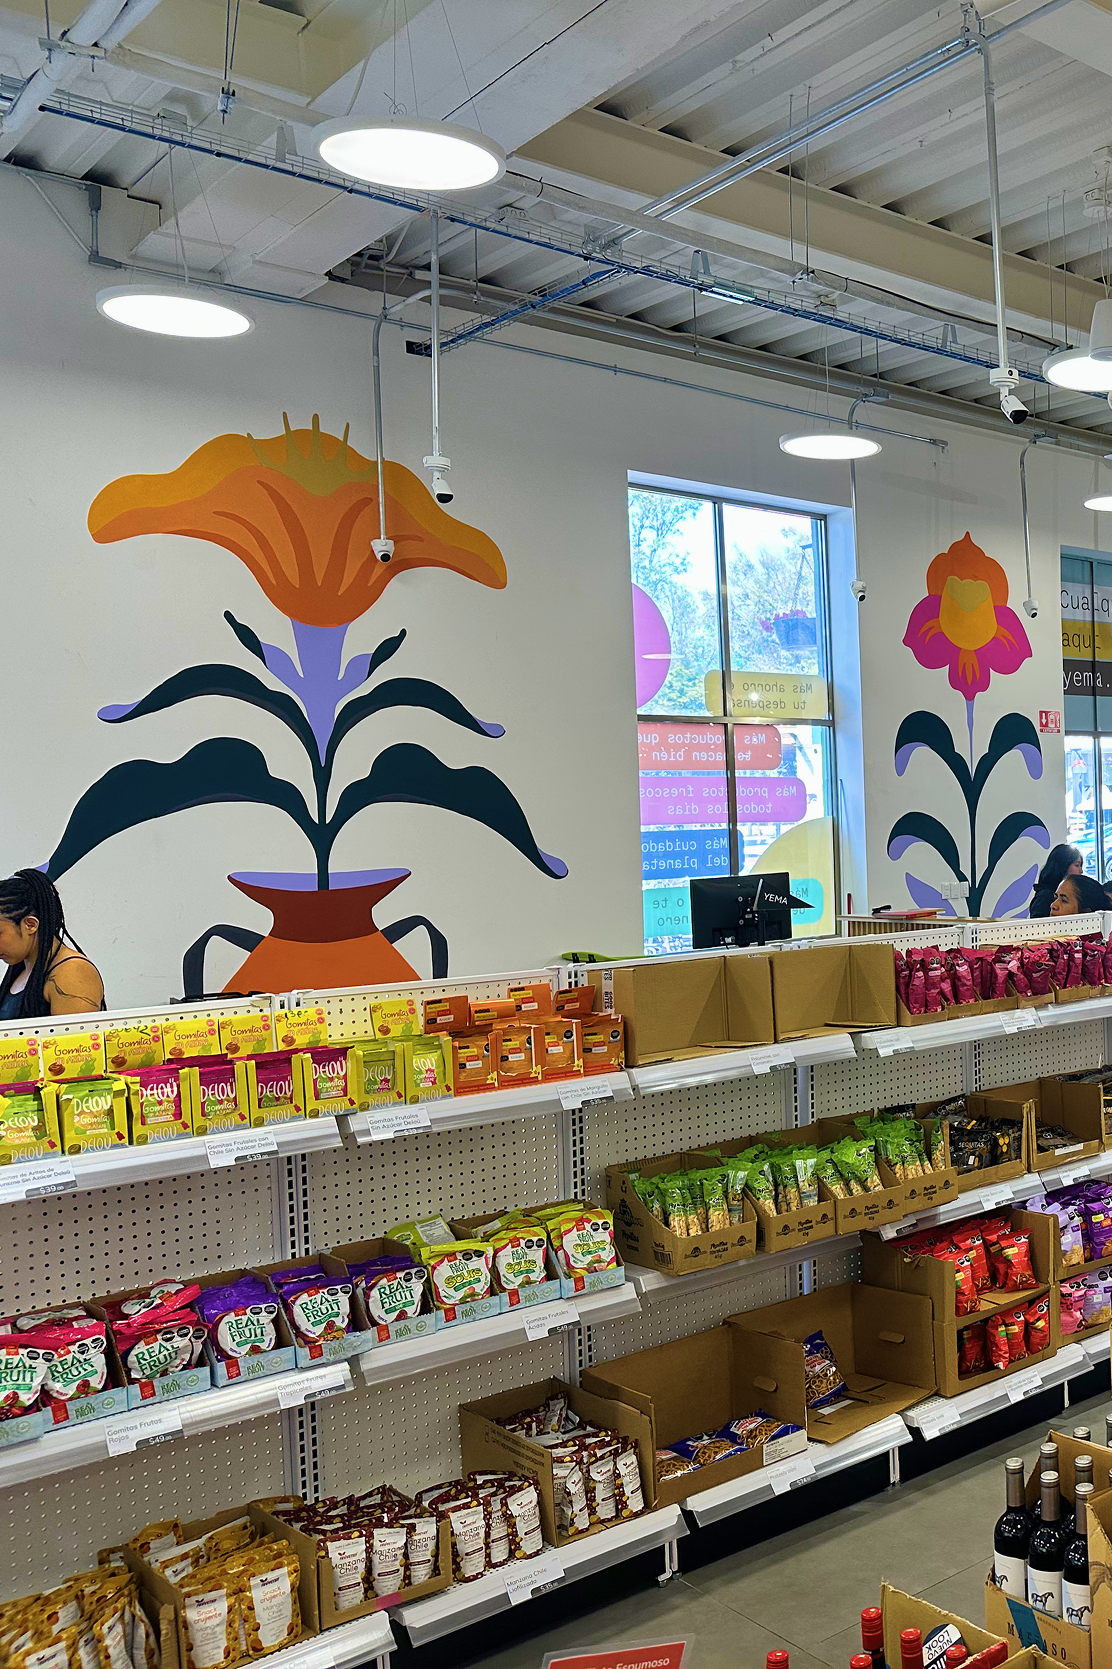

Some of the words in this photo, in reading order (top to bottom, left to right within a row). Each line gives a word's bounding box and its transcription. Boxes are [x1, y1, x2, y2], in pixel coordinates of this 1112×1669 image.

[763, 891, 789, 906] YEMA
[174, 1027, 208, 1041] Gomitas
[230, 1022, 263, 1037] Gomitas
[54, 1044, 92, 1057] Gomitas
[117, 1036, 152, 1050] Gomitas
[312, 1057, 347, 1079] DELOÜ
[139, 1078, 178, 1103] DELOÜ
[200, 1078, 236, 1103] DELOÜ
[257, 1076, 292, 1101] DELOÜ
[74, 1091, 112, 1114] DELOÜ
[264, 1107, 291, 1126] DELOÜ
[369, 1117, 394, 1126] Gomitas
[395, 1113, 419, 1122] Frutales
[206, 1116, 235, 1135] DELOÜ
[371, 1123, 381, 1131] Sin
[382, 1120, 403, 1129] Azúcar
[147, 1125, 177, 1144] DELOÜ
[81, 1134, 113, 1154] DELOÜ
[207, 1140, 233, 1151] Gomitas
[234, 1136, 258, 1147] Frutales
[209, 1147, 224, 1156] Chile
[225, 1146, 235, 1154] Sin
[235, 1142, 257, 1153] Azúcar
[258, 1140, 275, 1149] Deloü
[11, 1143, 44, 1163] DELOÜ
[32, 1173, 53, 1183] Azúcar
[377, 1275, 414, 1302] REAL
[380, 1288, 415, 1310] FRUIT
[304, 1299, 342, 1323] FRUIT
[525, 1315, 548, 1325] Gomitas
[548, 1309, 569, 1320] Frutales
[225, 1314, 265, 1332] REAL
[229, 1324, 267, 1343] FRUIT
[107, 1423, 138, 1438] Gomitas
[139, 1417, 163, 1430] Frutos
[108, 1433, 130, 1446] Rojos
[454, 1523, 486, 1539] Manzana
[463, 1530, 481, 1542] Chile
[332, 1556, 367, 1571] Manzana
[377, 1551, 399, 1563] Chile
[338, 1563, 360, 1575] Chile
[506, 1572, 534, 1588] Manzana
[533, 1567, 548, 1578] Chile
[508, 1578, 538, 1595] Liofilizada
[259, 1590, 287, 1605] crujiente
[193, 1611, 222, 1625] crujiente
[926, 1630, 950, 1653] LOOK
[927, 1637, 953, 1661] NUEVO
[615, 1656, 671, 1669] Espumoso
